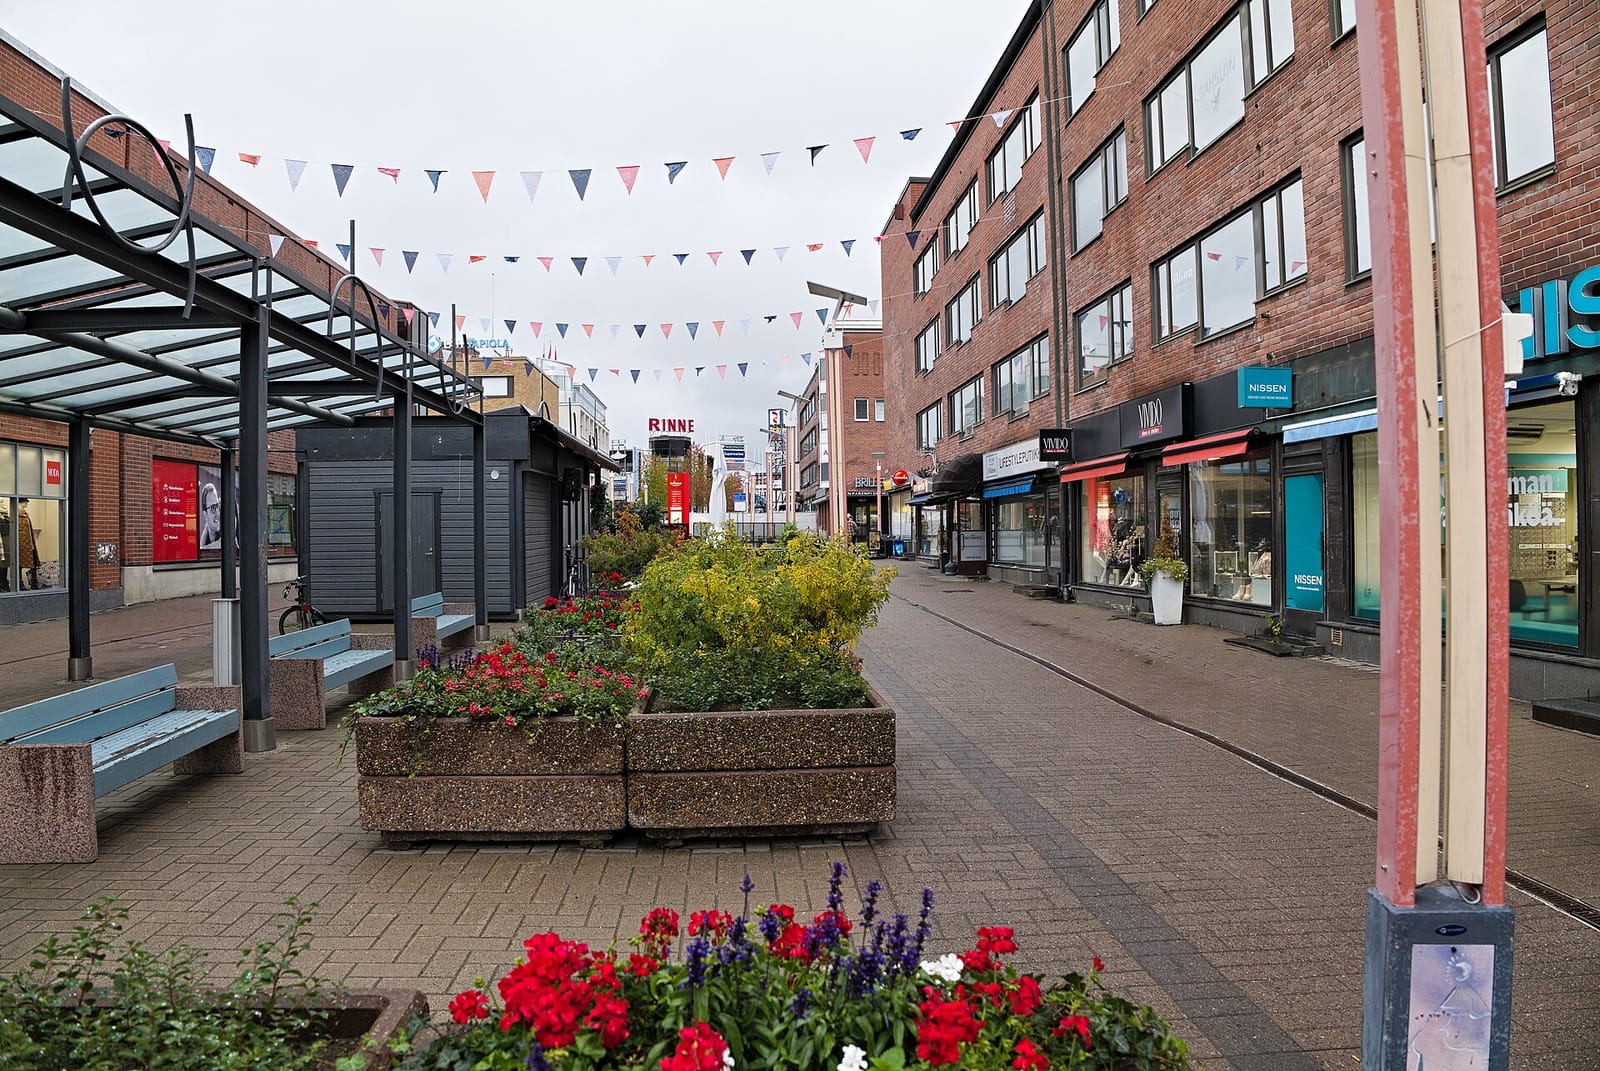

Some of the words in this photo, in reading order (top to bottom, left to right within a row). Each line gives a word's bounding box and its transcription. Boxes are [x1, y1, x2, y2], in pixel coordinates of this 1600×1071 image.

[1249, 383, 1287, 393] NISSEN
[1137, 398, 1163, 429] VIVIDO
[648, 418, 694, 432] RINNE
[1043, 437, 1069, 449] VIVIDO
[1294, 574, 1323, 586] NISSEN
